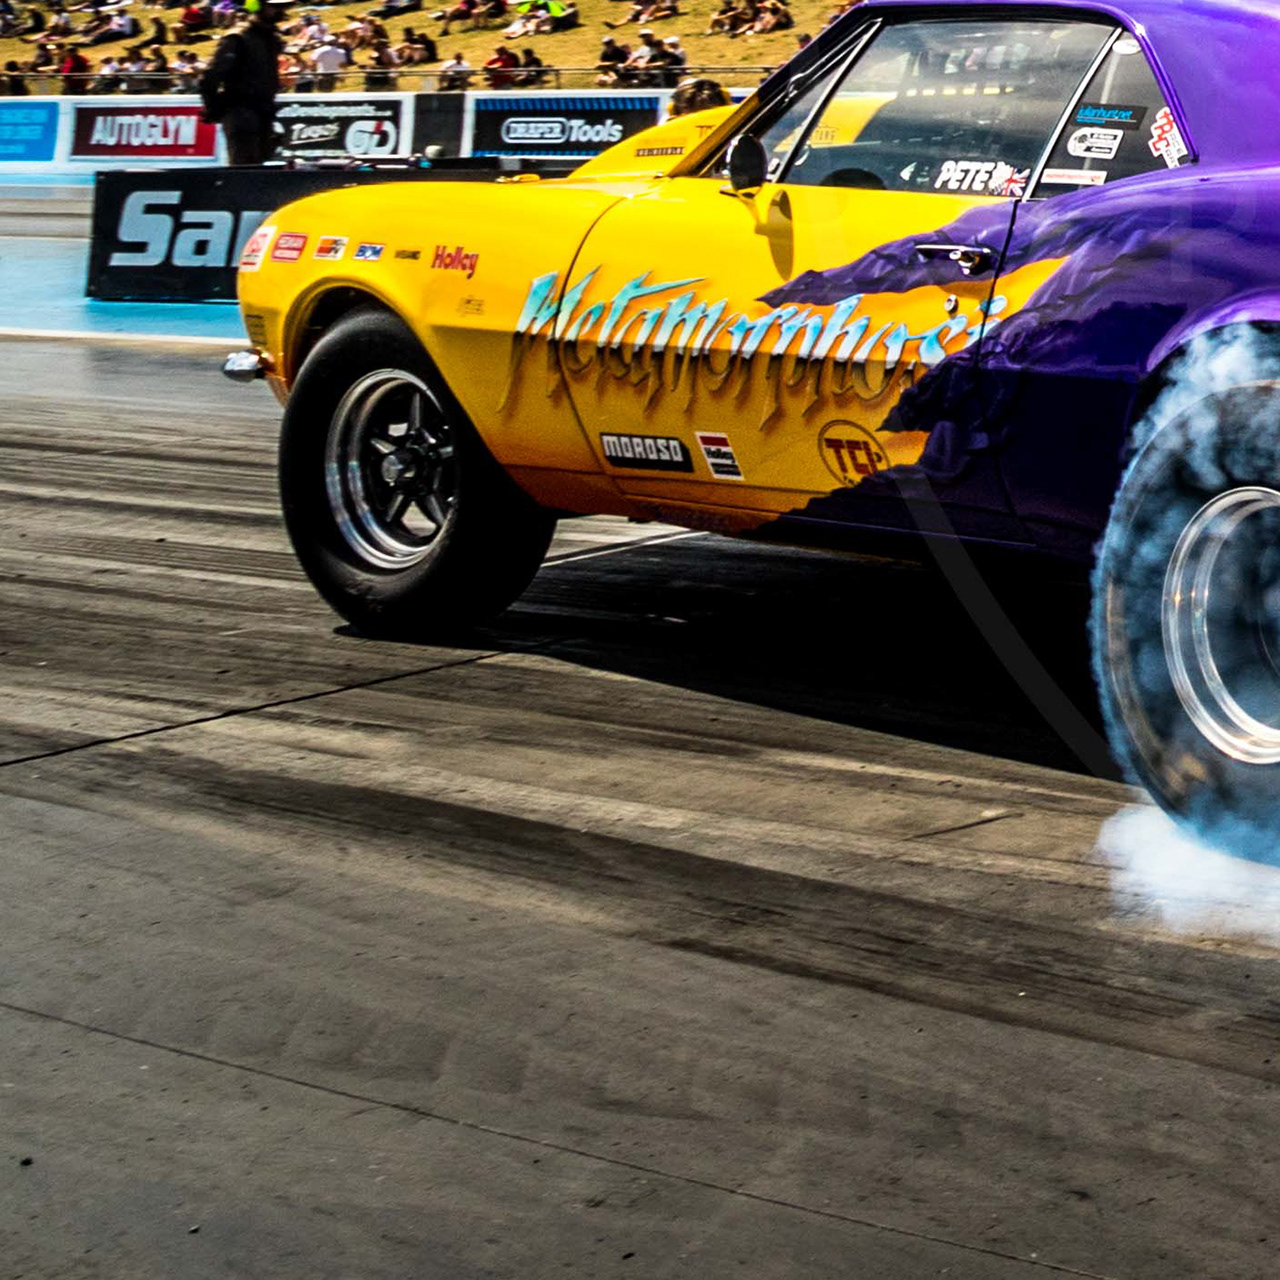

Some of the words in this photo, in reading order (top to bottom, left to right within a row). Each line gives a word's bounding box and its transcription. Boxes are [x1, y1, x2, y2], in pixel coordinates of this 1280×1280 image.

[89, 114, 198, 146] AUTOGLYM
[508, 122, 564, 140] DRAPER
[568, 120, 624, 143] Tools
[934, 160, 995, 191] PETE
[430, 245, 479, 279] Holley
[601, 434, 684, 463] MOROSO
[823, 437, 879, 475] TCI
